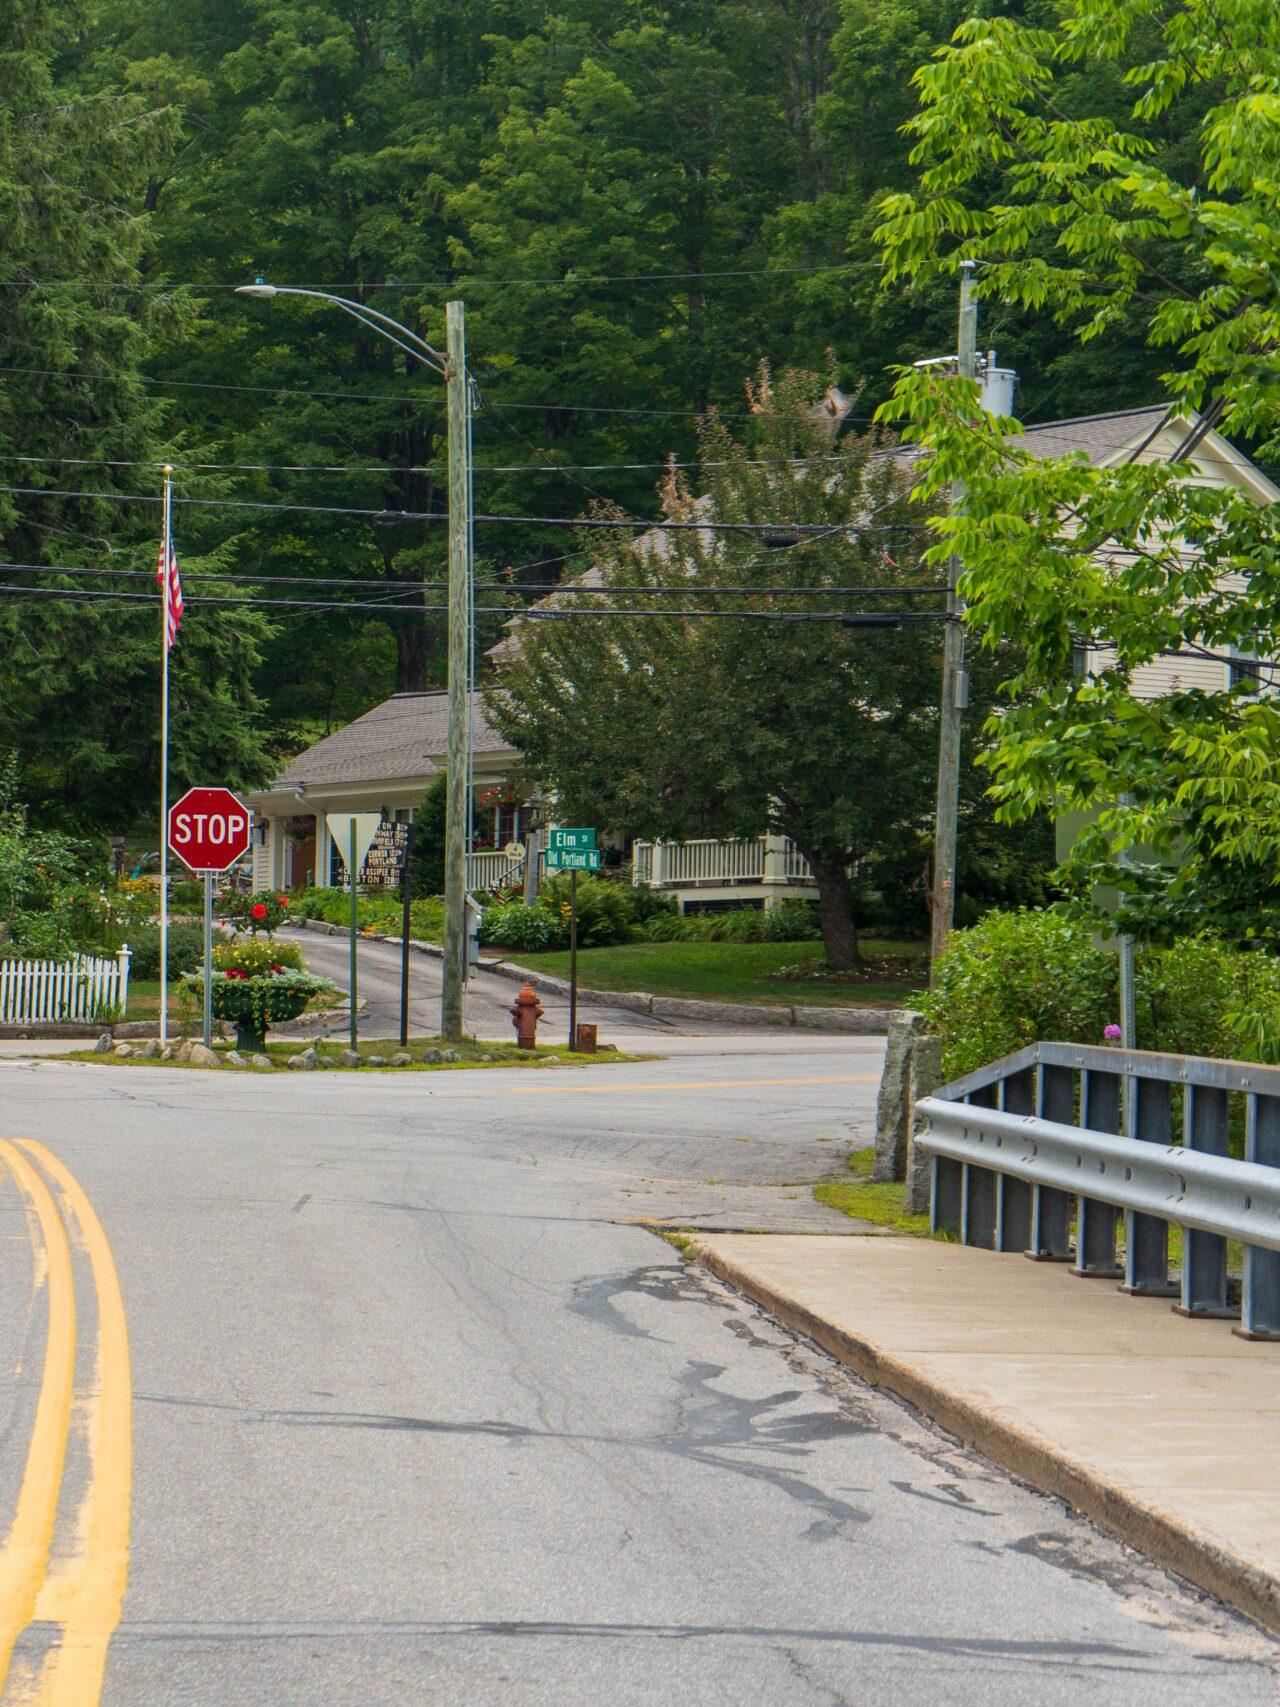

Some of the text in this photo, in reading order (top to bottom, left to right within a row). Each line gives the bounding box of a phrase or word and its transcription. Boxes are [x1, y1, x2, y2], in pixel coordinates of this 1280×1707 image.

[175, 813, 245, 845] STOP
[556, 832, 576, 847] Elm
[368, 857, 397, 865] PORTLAND
[548, 850, 597, 868] Old Portland Rd
[344, 875, 379, 883] BSTON
